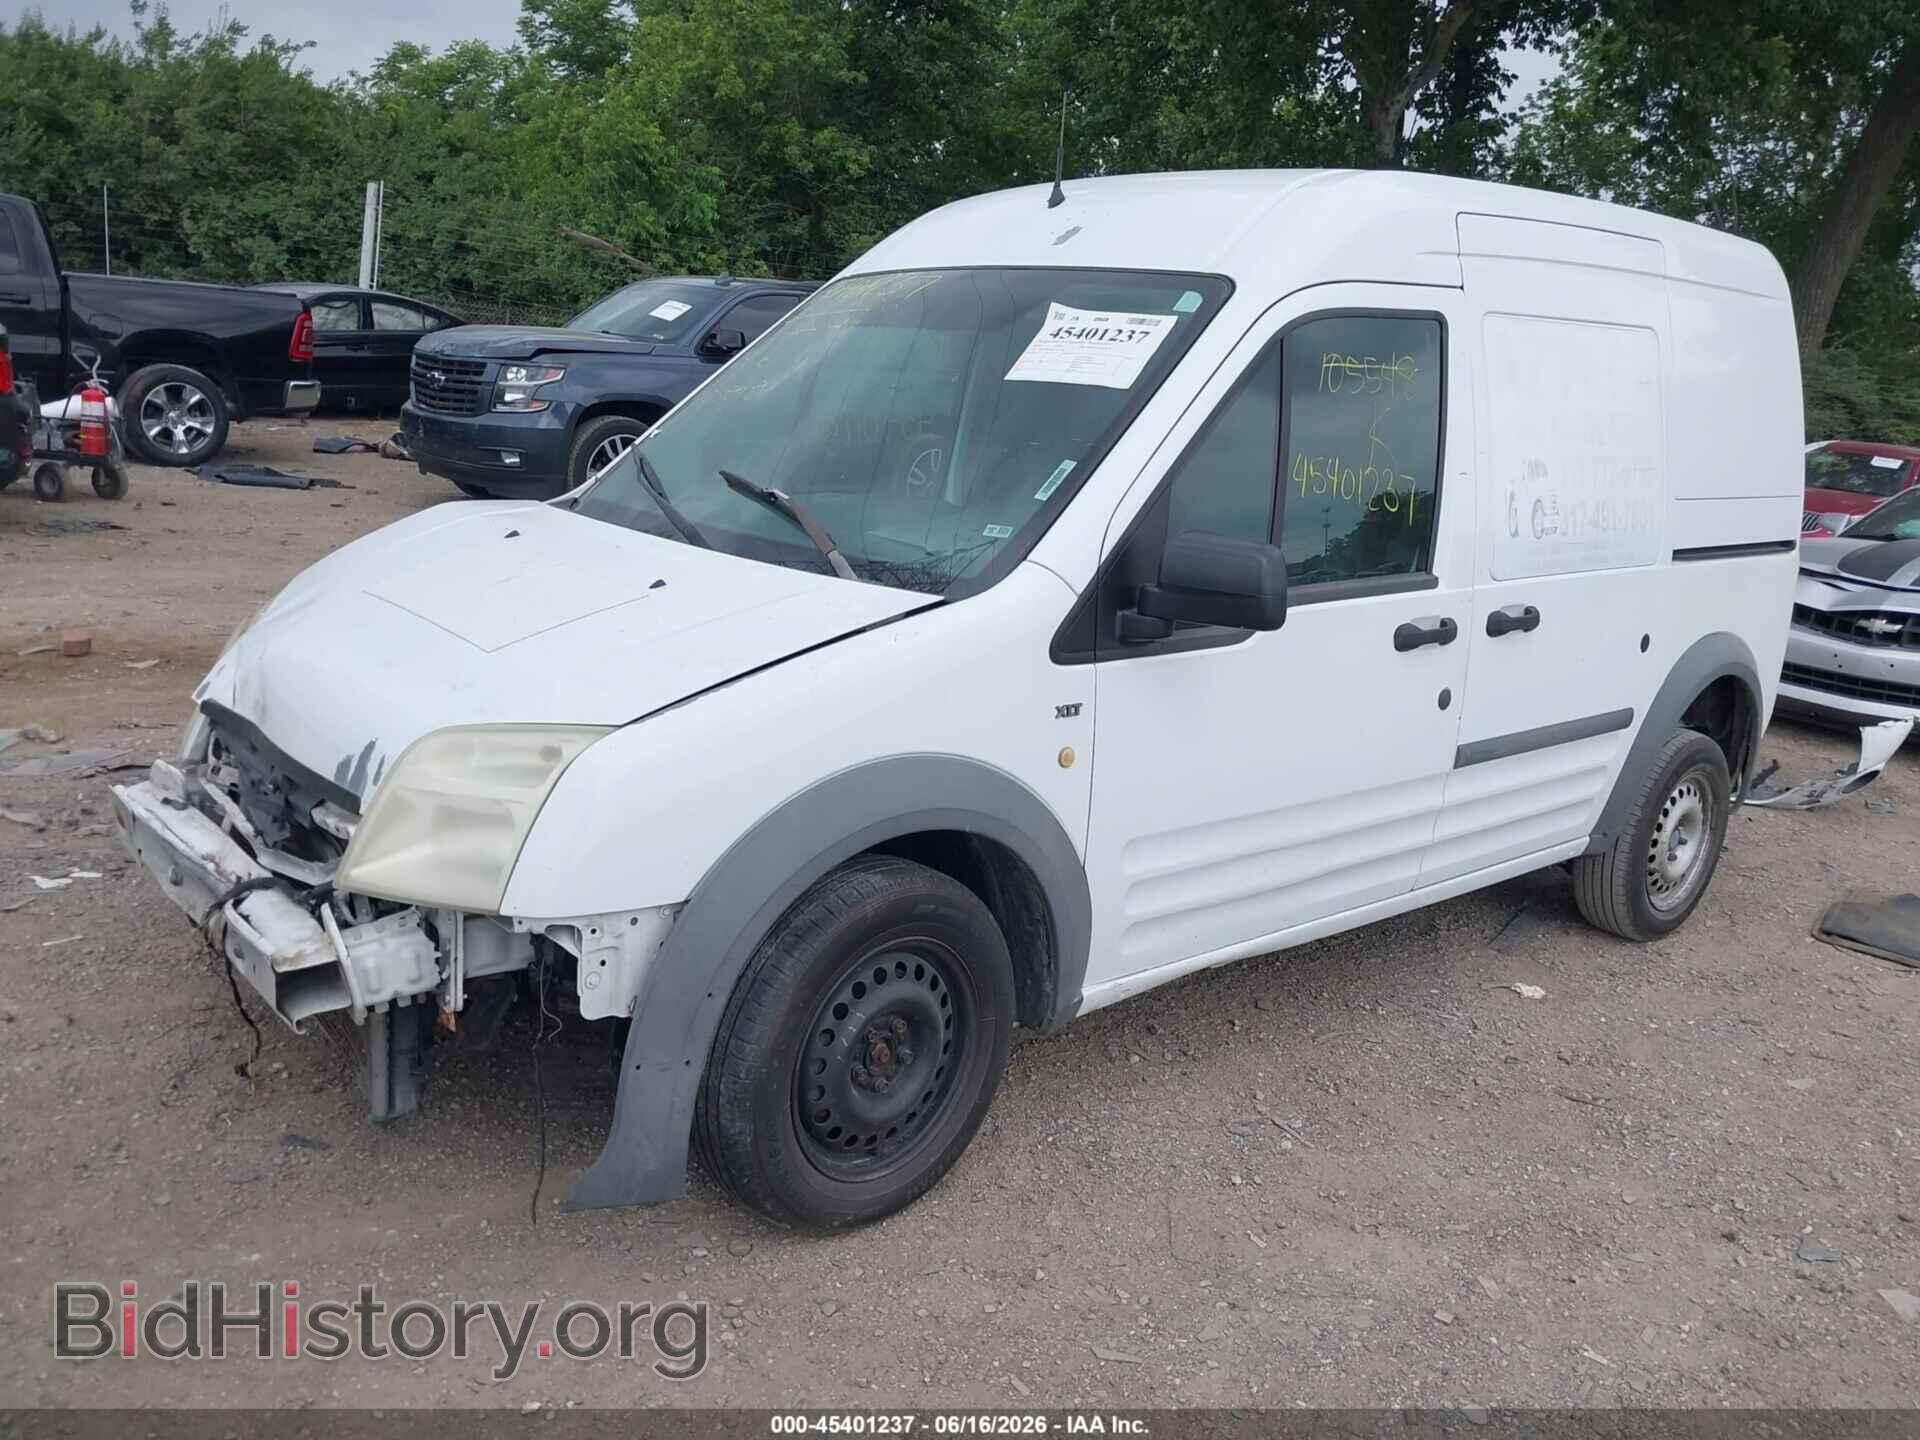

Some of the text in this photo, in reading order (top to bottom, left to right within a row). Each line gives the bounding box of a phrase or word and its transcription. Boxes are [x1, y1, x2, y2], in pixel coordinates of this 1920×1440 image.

[1049, 326, 1151, 344] 45401237
[1293, 453, 1416, 527] 45401237
[1055, 702, 1083, 719] XLT
